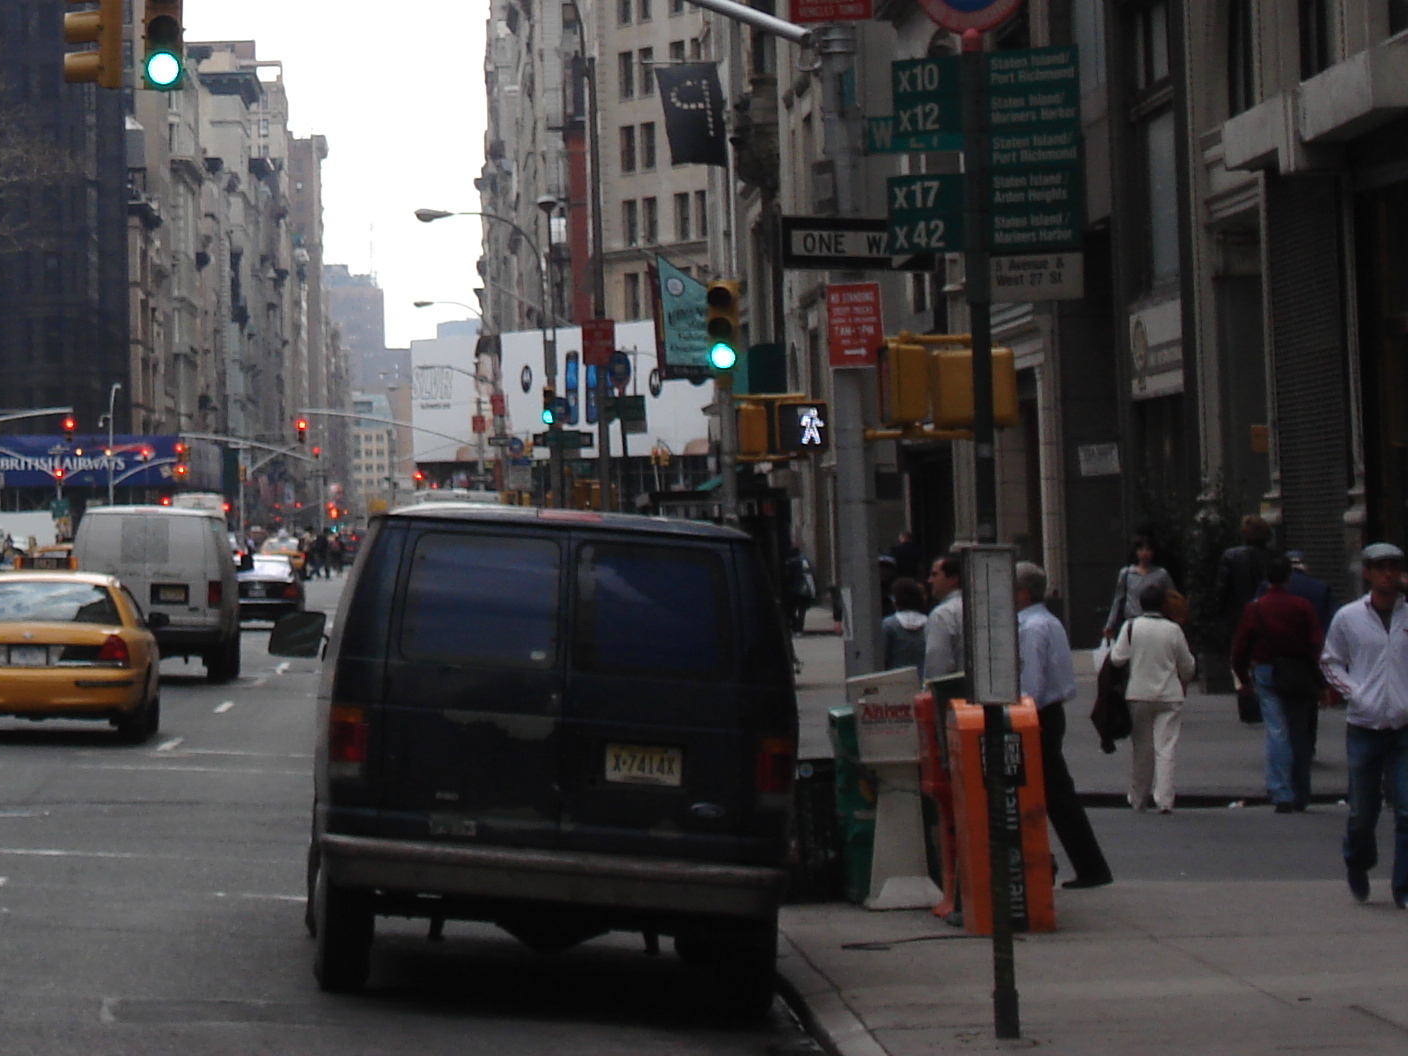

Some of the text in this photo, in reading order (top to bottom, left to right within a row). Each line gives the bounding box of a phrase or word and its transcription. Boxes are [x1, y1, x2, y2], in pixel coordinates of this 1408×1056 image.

[991, 57, 1028, 70] Staten
[991, 66, 1075, 85] Port Richmond
[992, 136, 1030, 149] Staten
[992, 145, 1077, 165] Port Richmond
[803, 232, 847, 255] ONE
[996, 260, 1003, 272] 5
[1008, 259, 1049, 271] Avenue
[996, 274, 1024, 287] West
[1029, 272, 1043, 286] 27
[62, 456, 126, 472] AIRWAYS
